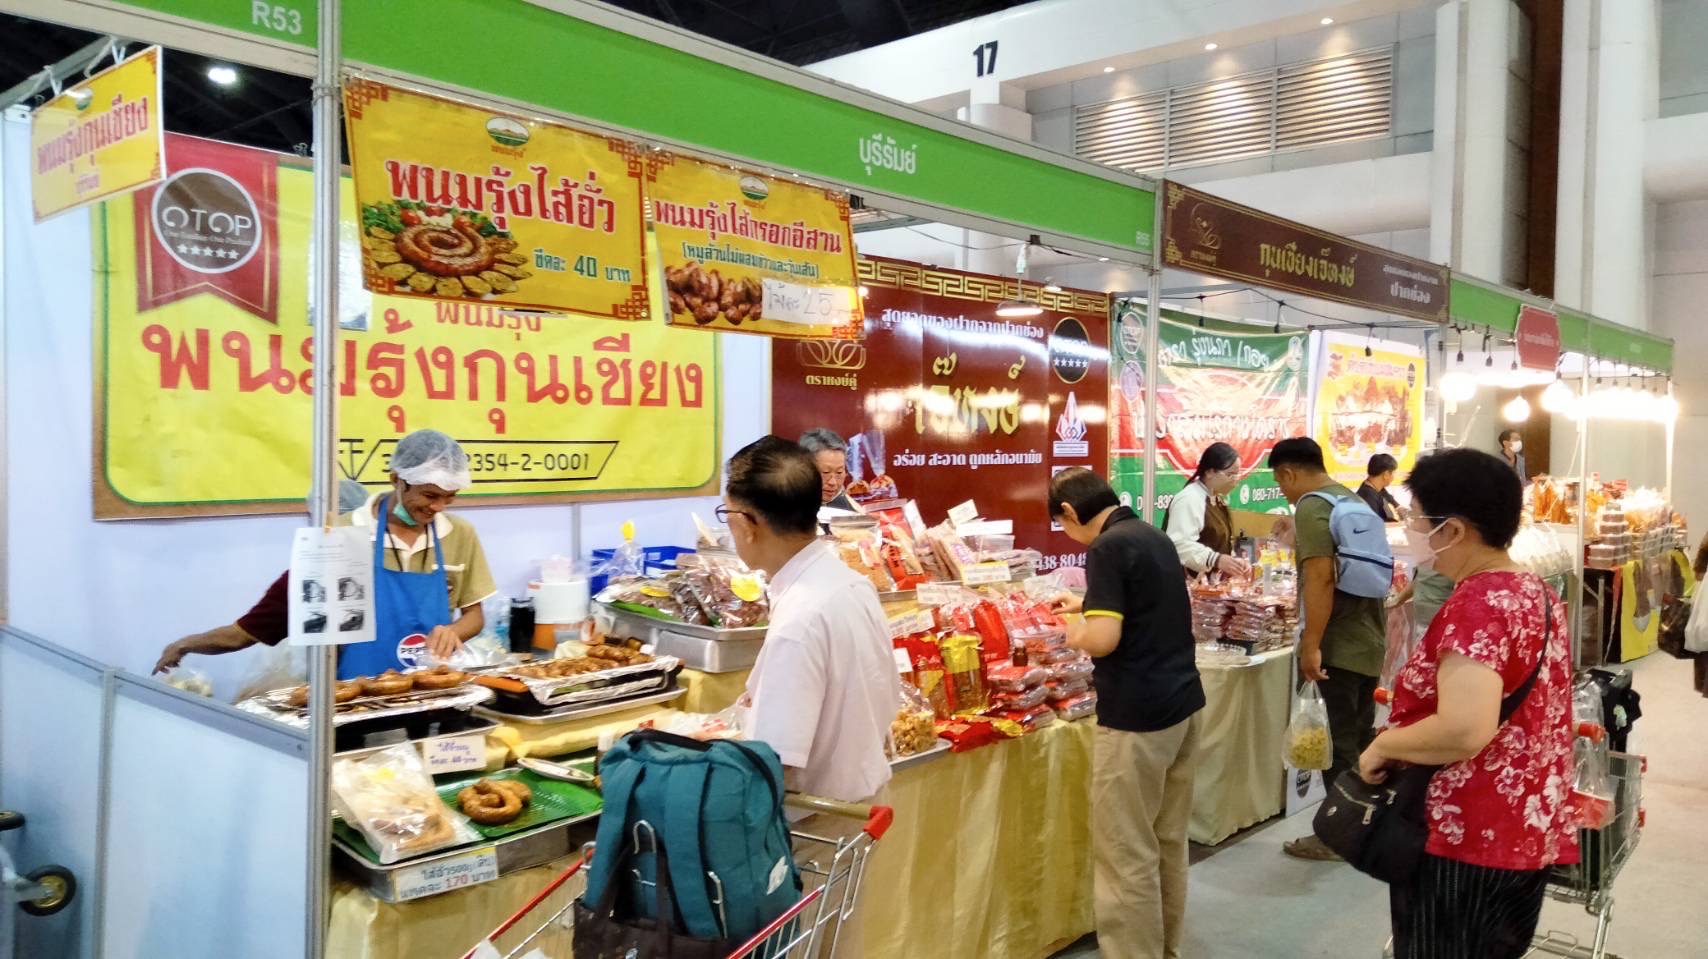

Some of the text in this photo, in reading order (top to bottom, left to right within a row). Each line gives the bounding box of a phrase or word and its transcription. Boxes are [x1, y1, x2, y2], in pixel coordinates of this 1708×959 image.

[252, 0, 302, 34] R53
[973, 40, 998, 77] 17
[859, 133, 917, 176] บุรีรัมย์
[162, 206, 252, 236] OTOP
[574, 255, 598, 278] 40
[605, 266, 630, 282] บาท
[893, 449, 925, 467] อร่อย
[928, 452, 966, 467] สะอาด
